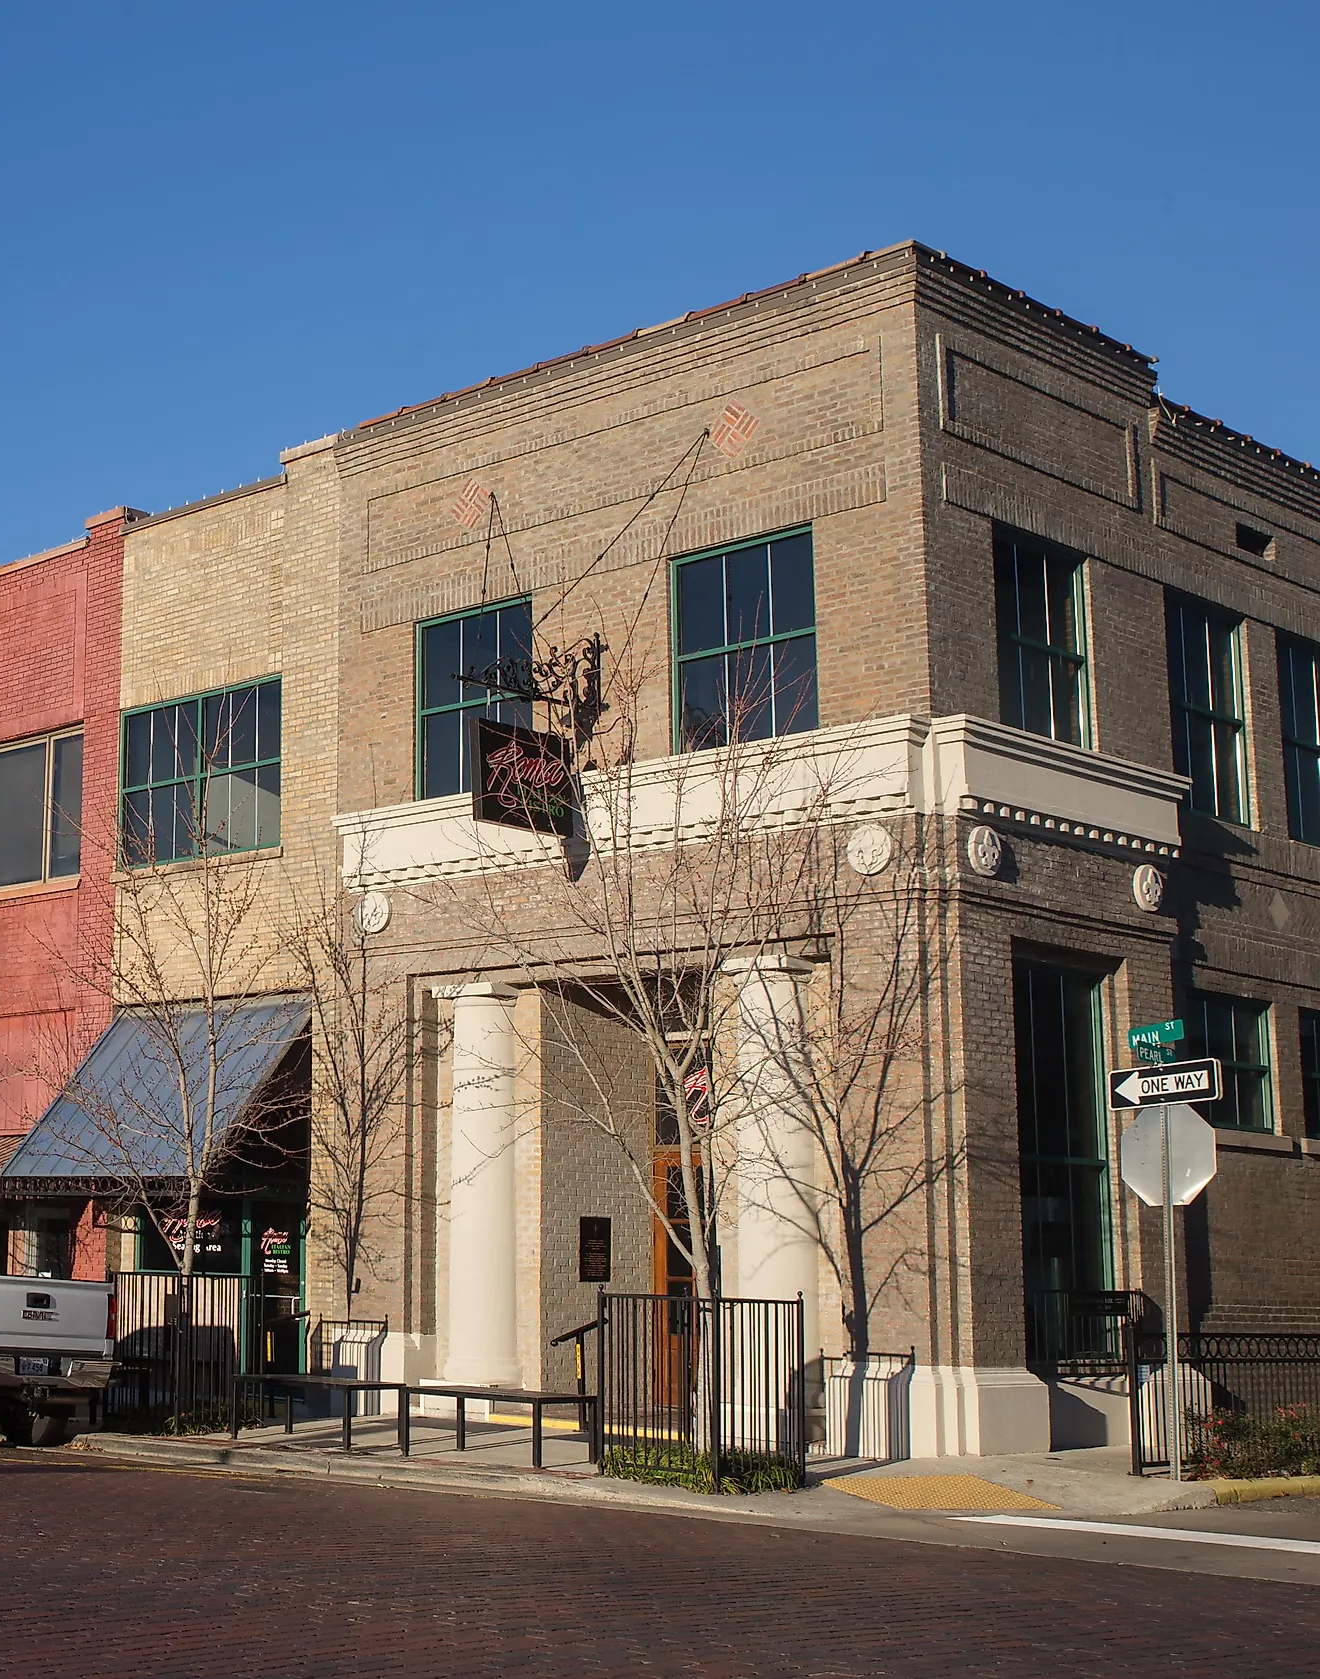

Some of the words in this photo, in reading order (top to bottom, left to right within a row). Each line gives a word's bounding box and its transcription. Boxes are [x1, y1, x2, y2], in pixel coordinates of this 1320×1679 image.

[487, 740, 565, 807] Roma
[521, 798, 565, 818] ISTRO
[1132, 1031, 1159, 1046] MAIN
[1165, 1021, 1174, 1031] ST
[1140, 1047, 1162, 1061] PEARL
[1166, 1049, 1173, 1057] ST
[1141, 1077, 1168, 1094] ONE
[1174, 1073, 1204, 1090] WAY
[23, 1310, 54, 1320] GMC
